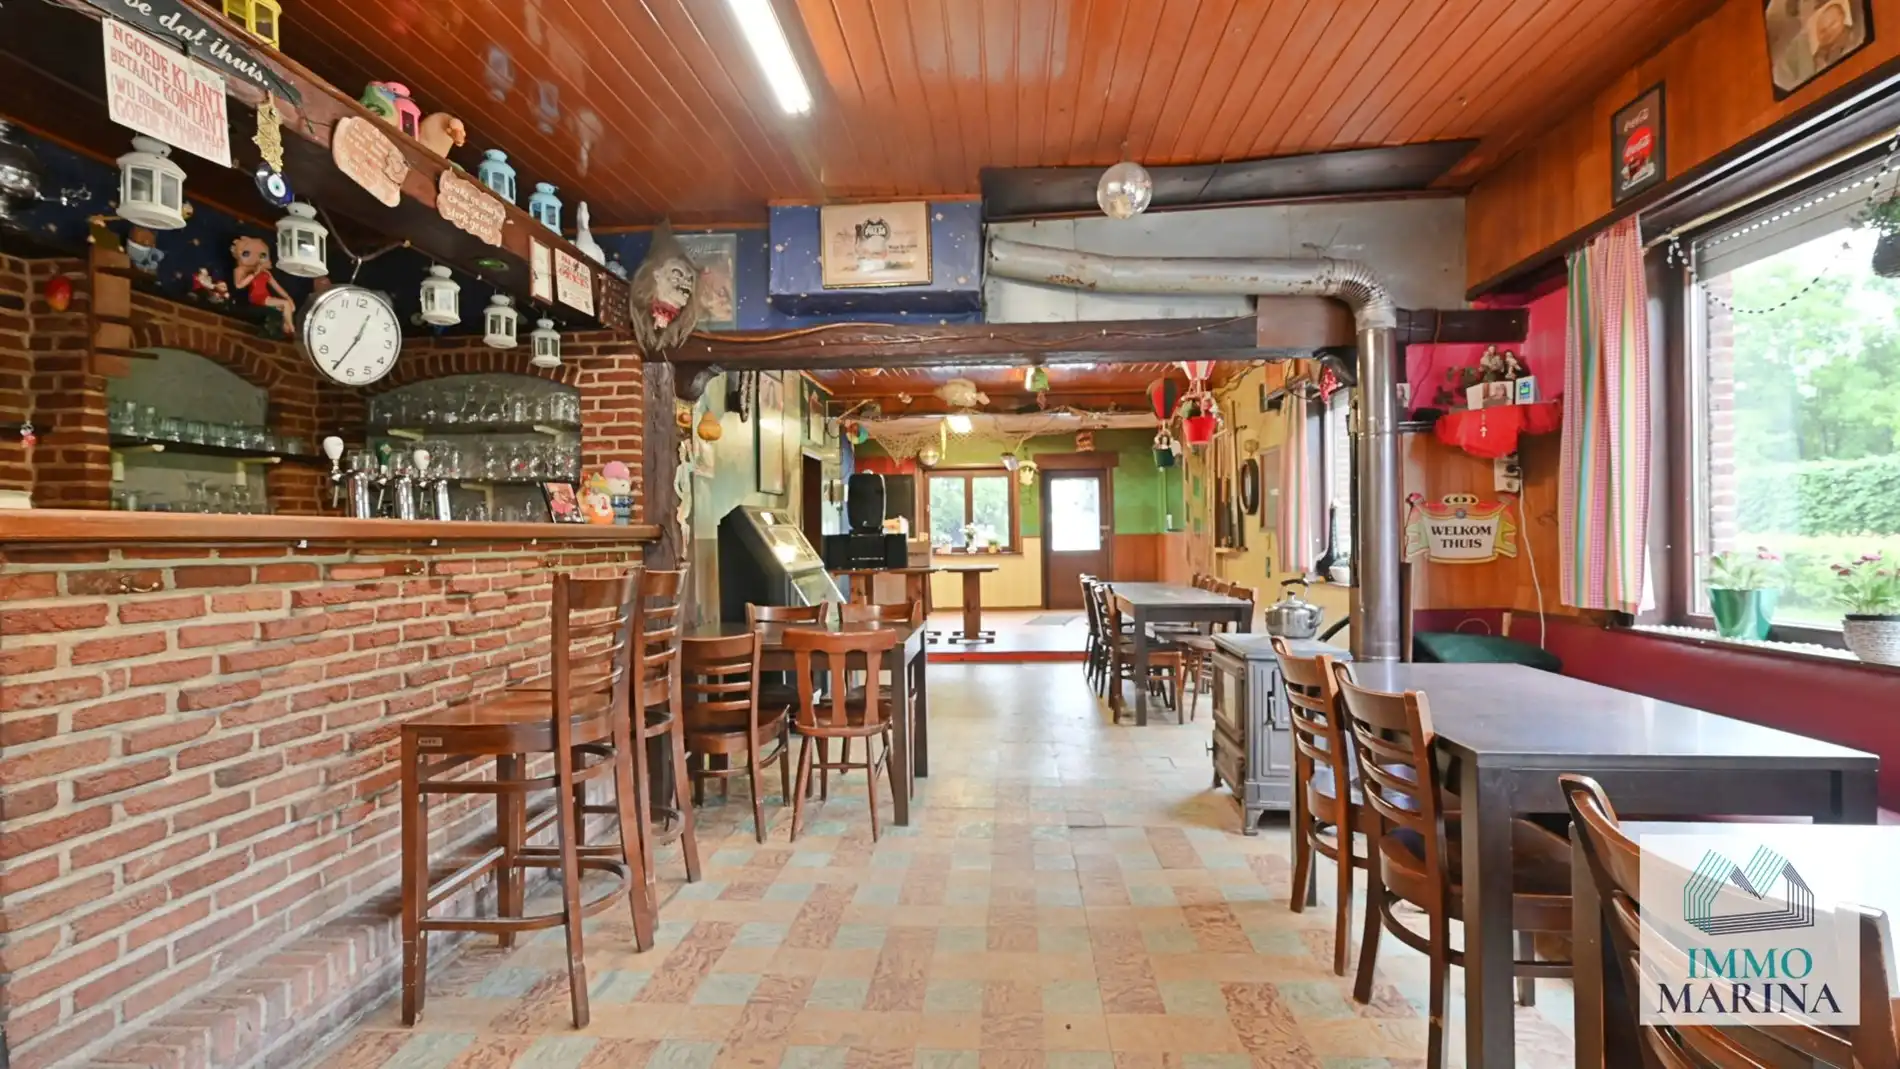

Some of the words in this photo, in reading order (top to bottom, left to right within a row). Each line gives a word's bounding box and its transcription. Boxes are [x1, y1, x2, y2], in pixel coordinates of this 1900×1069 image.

[159, 12, 208, 46] dat
[125, 32, 168, 81] GOEDE
[172, 63, 224, 120] KLANT
[110, 47, 161, 94] BETAALT
[162, 80, 226, 143] KONTANT
[341, 299, 349, 309] 11
[356, 298, 368, 308] 12
[326, 309, 336, 319] 10
[375, 308, 380, 316] 1
[317, 326, 326, 335] 9
[383, 322, 391, 332] 2
[319, 344, 329, 354] 8
[383, 340, 392, 349] 3
[376, 356, 384, 364] 4
[346, 367, 355, 377] 6
[363, 366, 372, 375] 5
[1431, 525, 1492, 536] WELKOM
[1440, 538, 1483, 549] THUIS
